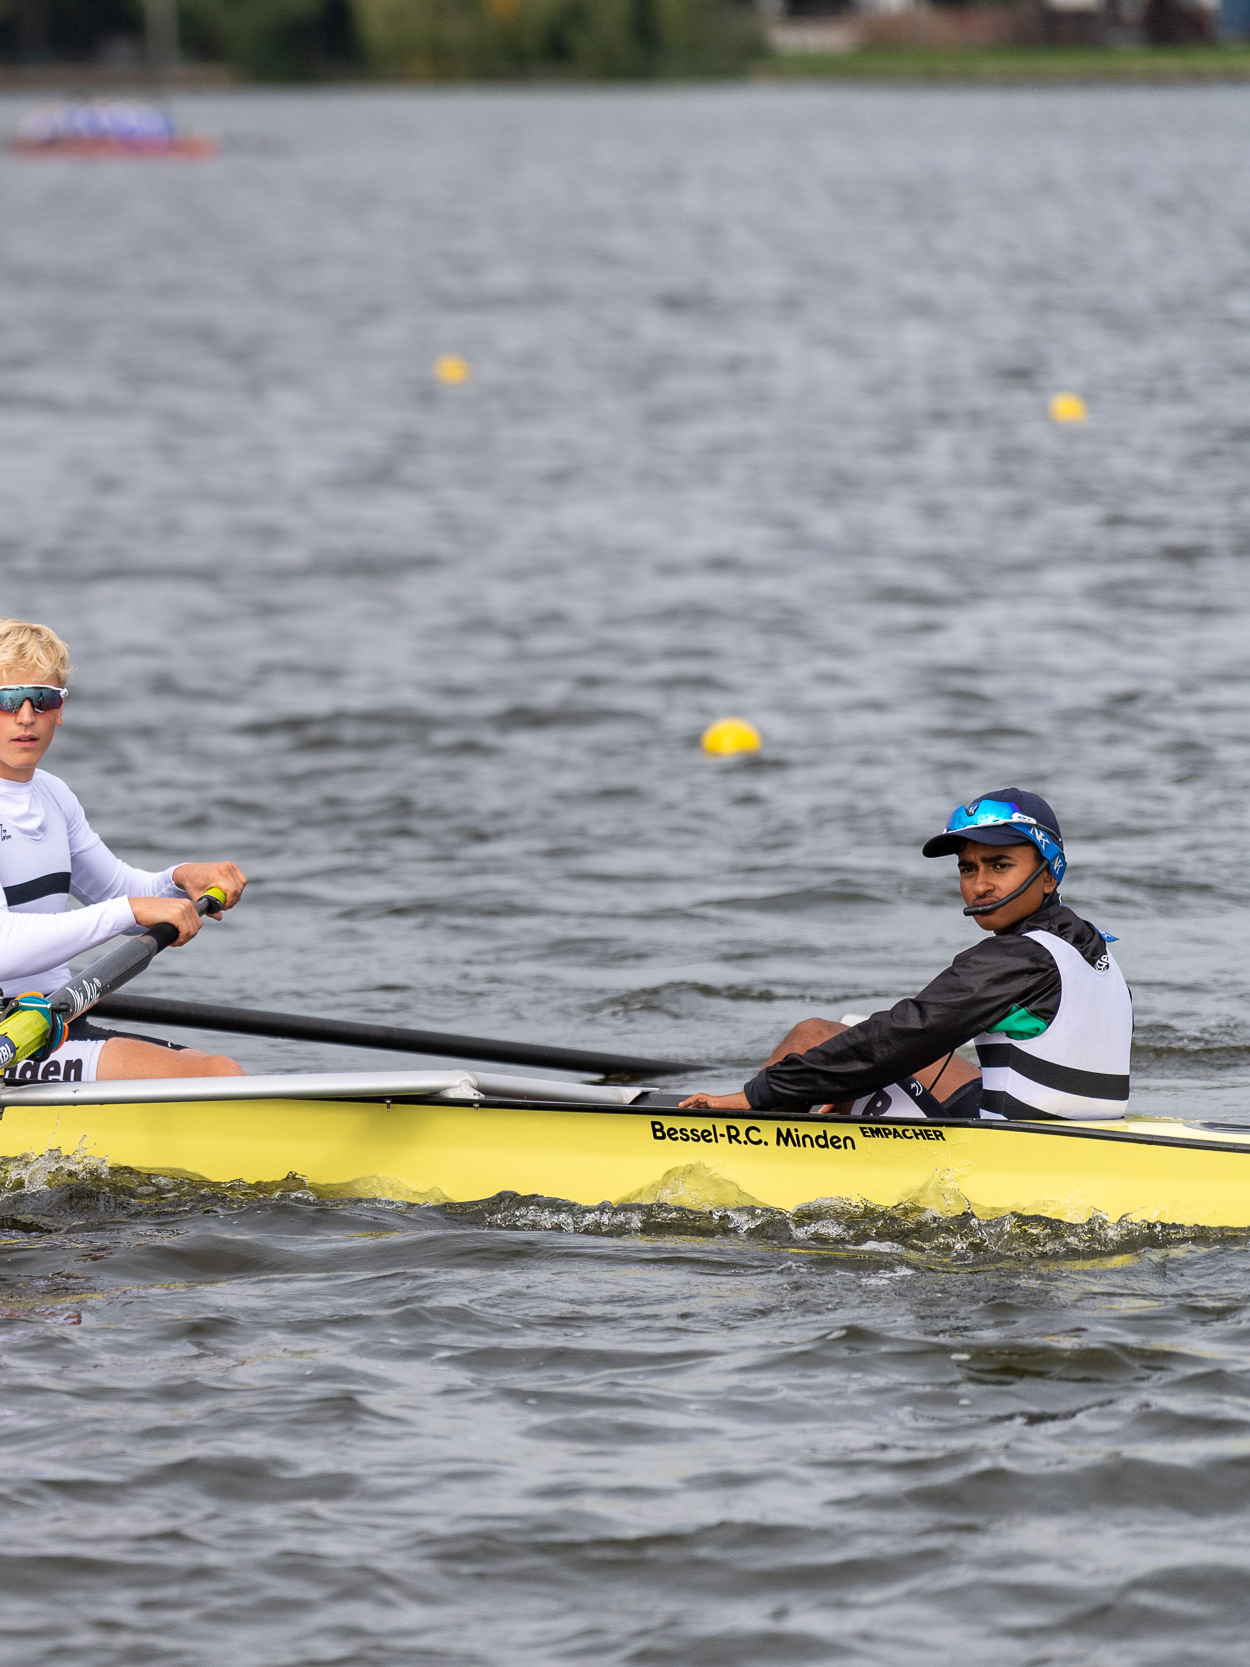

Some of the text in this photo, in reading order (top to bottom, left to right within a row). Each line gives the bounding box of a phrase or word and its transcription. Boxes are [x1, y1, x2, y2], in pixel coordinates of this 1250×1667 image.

[1029, 826, 1051, 852] NK
[1052, 855, 1064, 876] NK
[650, 1120, 857, 1151] Bessel-R.C. Minden
[858, 1126, 947, 1142] EMPACHER
